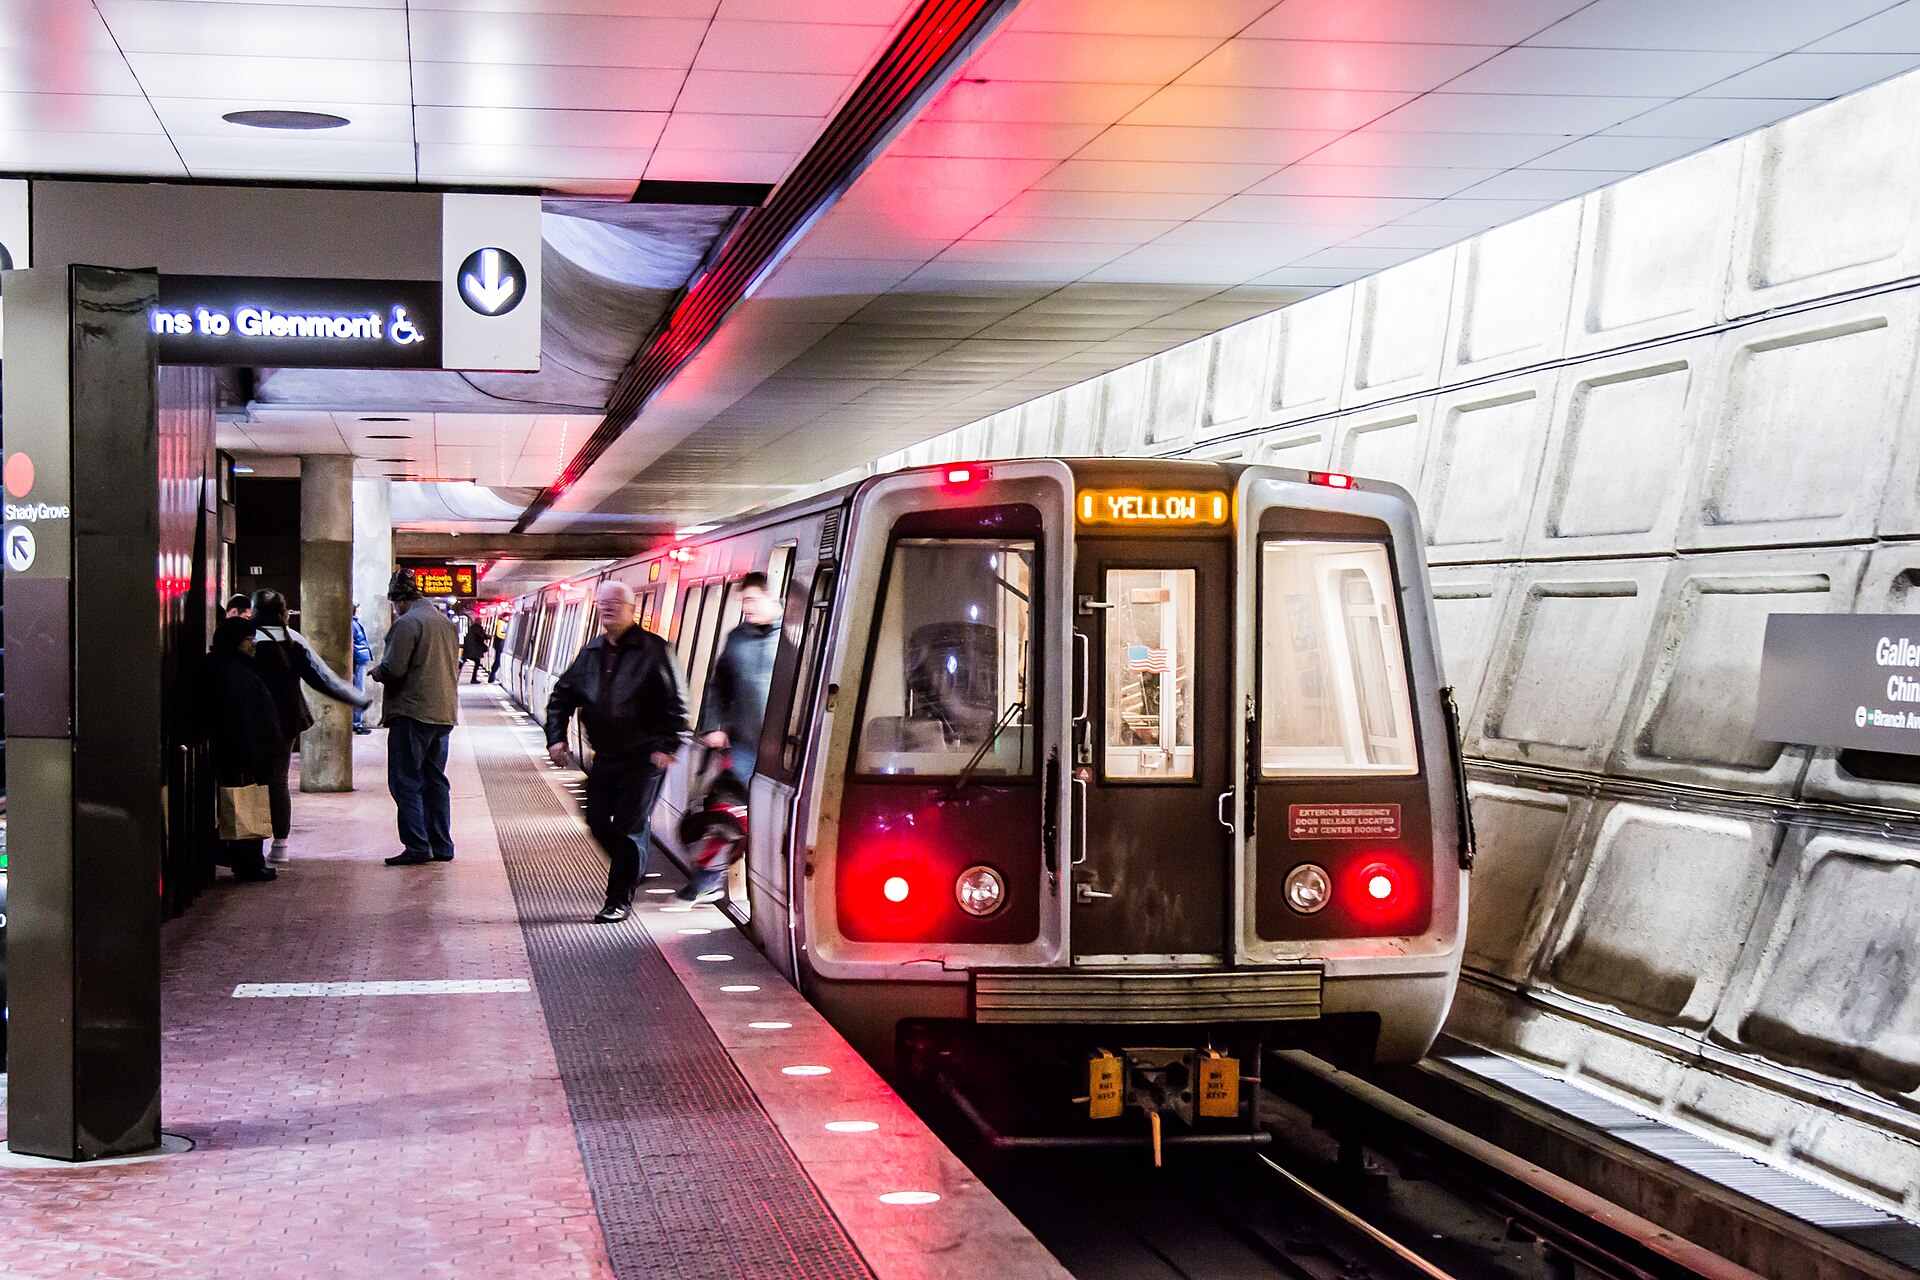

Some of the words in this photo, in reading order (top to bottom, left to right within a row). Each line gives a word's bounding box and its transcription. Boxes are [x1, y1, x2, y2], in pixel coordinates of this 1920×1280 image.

[196, 307, 230, 337] to
[235, 305, 382, 339] Glenmont
[5, 503, 38, 523] Shady
[38, 502, 70, 520] Grove
[1107, 496, 1196, 519] YELLOW
[1873, 709, 1906, 728] Branch
[1341, 808, 1391, 816] EMERGENCY
[1358, 817, 1395, 825] LOCATED
[1320, 826, 1353, 834] CENTER
